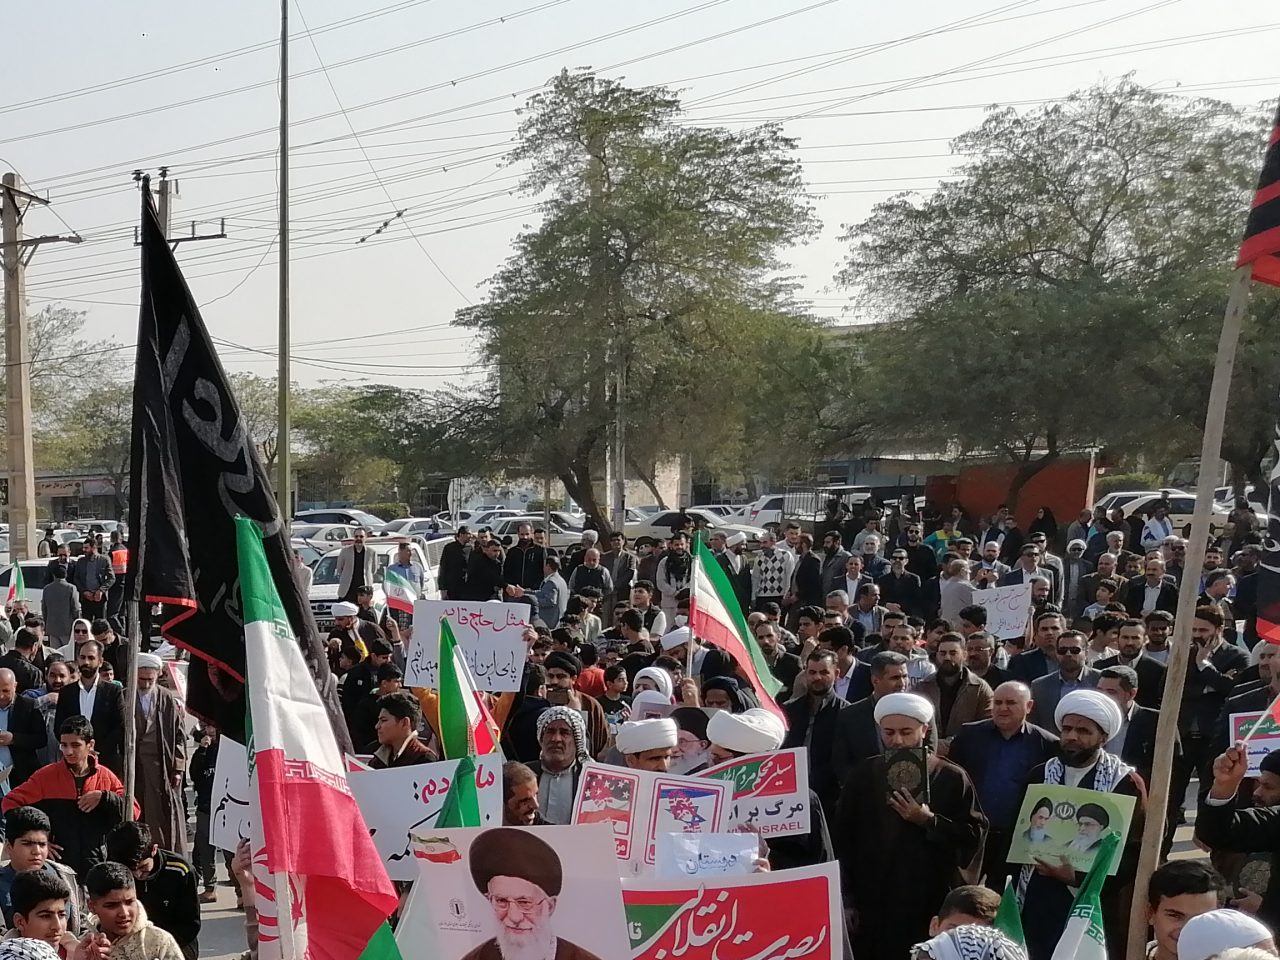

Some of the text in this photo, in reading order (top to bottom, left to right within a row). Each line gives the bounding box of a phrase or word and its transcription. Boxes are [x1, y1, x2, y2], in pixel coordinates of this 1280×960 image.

[744, 806, 760, 823] بر
[764, 800, 804, 819] مرگ
[759, 821, 805, 835] ISRAEL
[686, 853, 738, 875] دبستان
